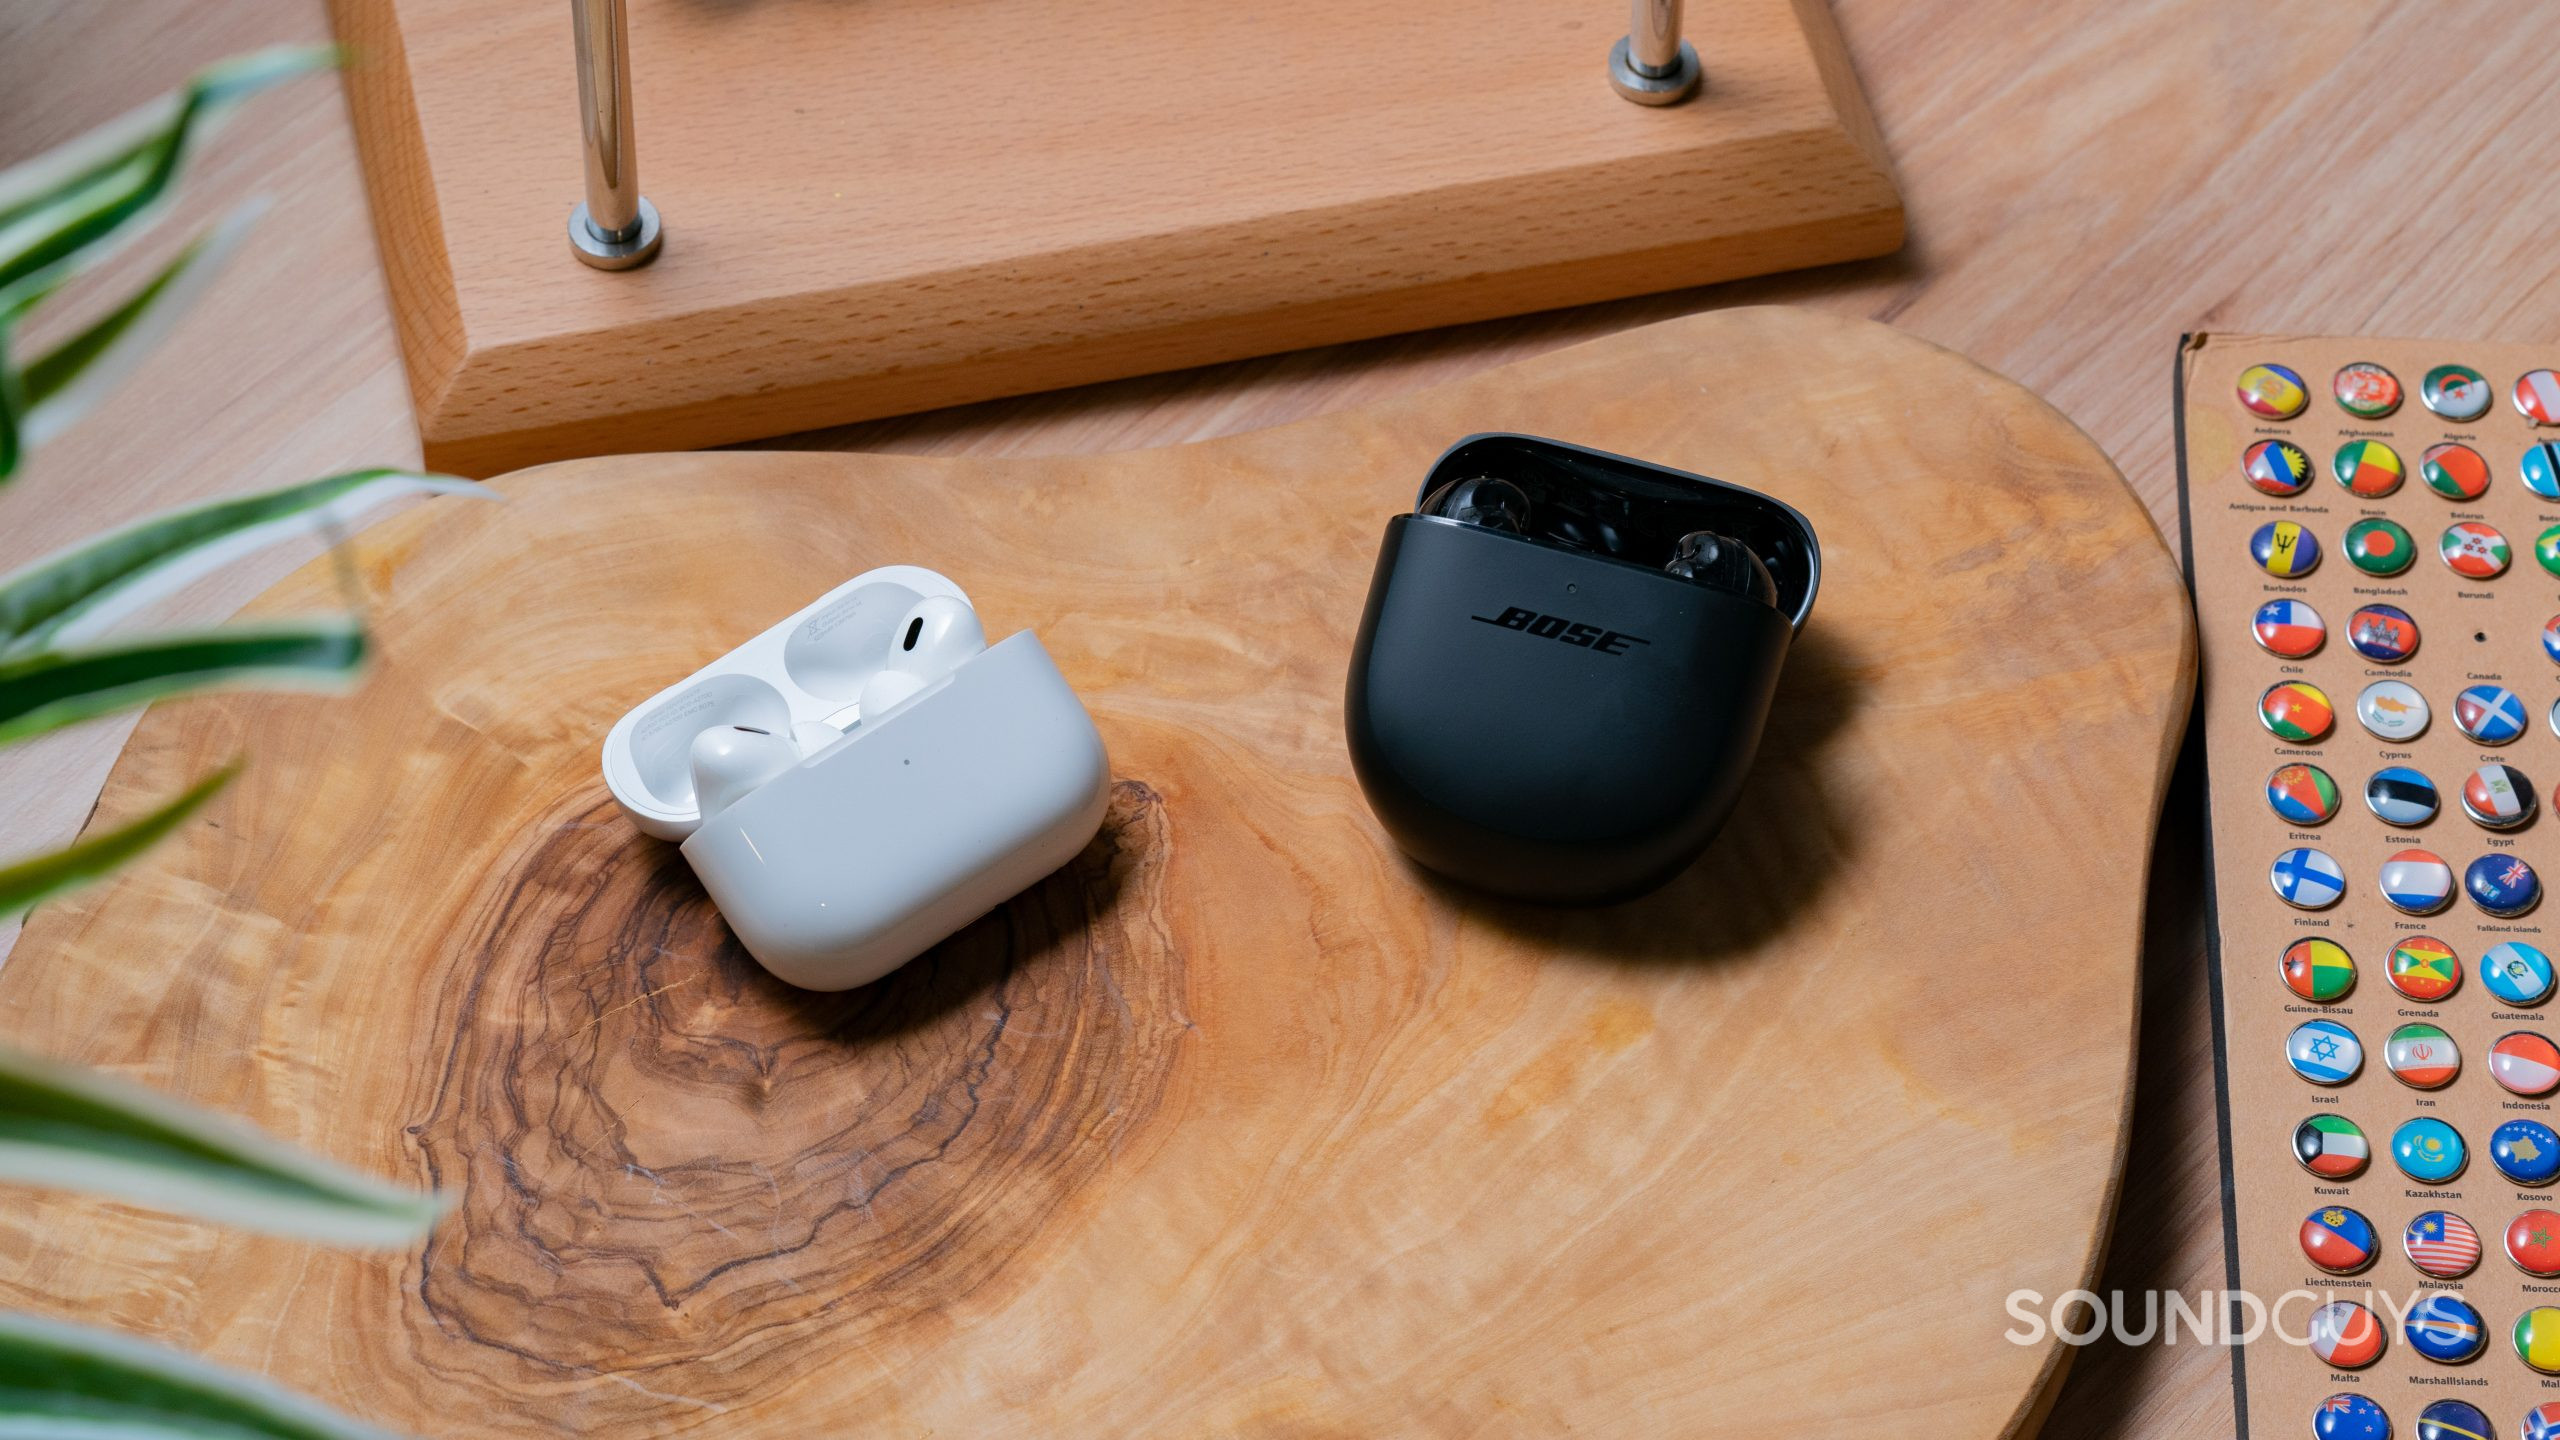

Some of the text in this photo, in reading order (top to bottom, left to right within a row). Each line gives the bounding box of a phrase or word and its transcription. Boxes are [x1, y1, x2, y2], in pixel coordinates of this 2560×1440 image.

[2263, 584, 2308, 593] Barbados
[2353, 587, 2408, 596] Bangladesh
[2458, 591, 2494, 600] Burundi
[1471, 606, 1650, 656] BOSE
[2280, 666, 2304, 674] Chile
[2364, 669, 2412, 678] Cambodia
[2466, 672, 2502, 681] Canada
[2274, 747, 2324, 757] Cameroon
[2379, 751, 2412, 760] Cyprus
[2479, 754, 2506, 763] Crete
[2289, 832, 2322, 841] Eritrea
[2385, 835, 2422, 844] Estonia
[2487, 838, 2515, 847] Egypt
[2294, 918, 2330, 927] Finland
[2394, 922, 2427, 930] France
[2477, 925, 2512, 933] Falkland
[2284, 1004, 2354, 1015] Guinea-Bissau
[2397, 1009, 2439, 1018] Grenada
[2491, 1012, 2545, 1021] Guatemala
[2311, 1095, 2339, 1104] Israel
[2416, 1099, 2436, 1107] Iran
[2502, 1101, 2551, 1111] Indonesia
[2314, 1186, 2350, 1196] Kuwait
[2405, 1190, 2462, 1199] Kazakhstan
[2516, 1192, 2553, 1202] Kosovo
[2305, 1278, 2372, 1288] Liechtenstein
[2418, 1280, 2464, 1291] Malaysia
[2522, 1284, 2560, 1293] Morocc
[2330, 1374, 2360, 1383] Malta
